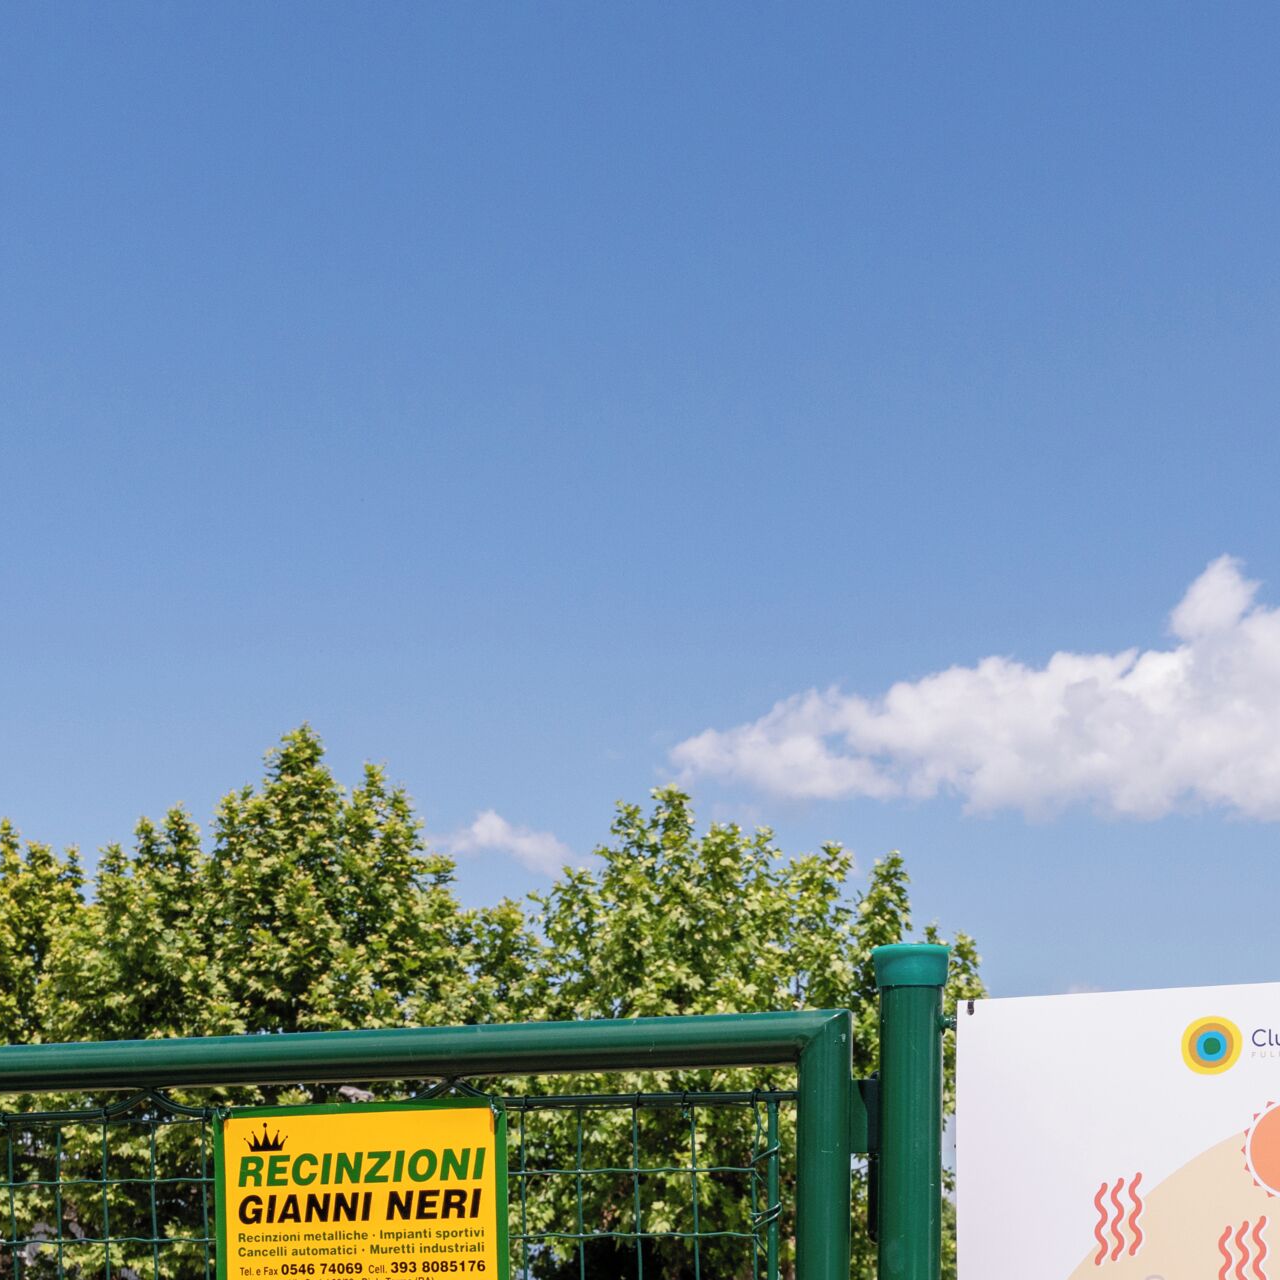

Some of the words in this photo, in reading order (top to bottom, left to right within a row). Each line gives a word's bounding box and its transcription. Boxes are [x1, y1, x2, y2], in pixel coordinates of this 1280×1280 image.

[238, 1147, 486, 1187] RECINZIONI
[238, 1192, 372, 1225] GIANNI
[386, 1188, 482, 1220] NERI
[238, 1232, 300, 1243] Recinzioni
[304, 1230, 368, 1241] metalliche
[380, 1228, 432, 1242] Impianti
[435, 1227, 484, 1240] sportivi
[238, 1246, 287, 1257] Cancelli
[291, 1245, 357, 1256] automatici
[370, 1243, 415, 1254] Muretti
[420, 1242, 484, 1253] industriali
[240, 1267, 254, 1276] Tel.
[263, 1266, 278, 1276] Fax
[281, 1263, 315, 1275] 0546
[320, 1262, 363, 1274] 74069
[368, 1264, 387, 1274] Cell.
[391, 1261, 417, 1274] 393
[422, 1260, 486, 1273] 8085176
